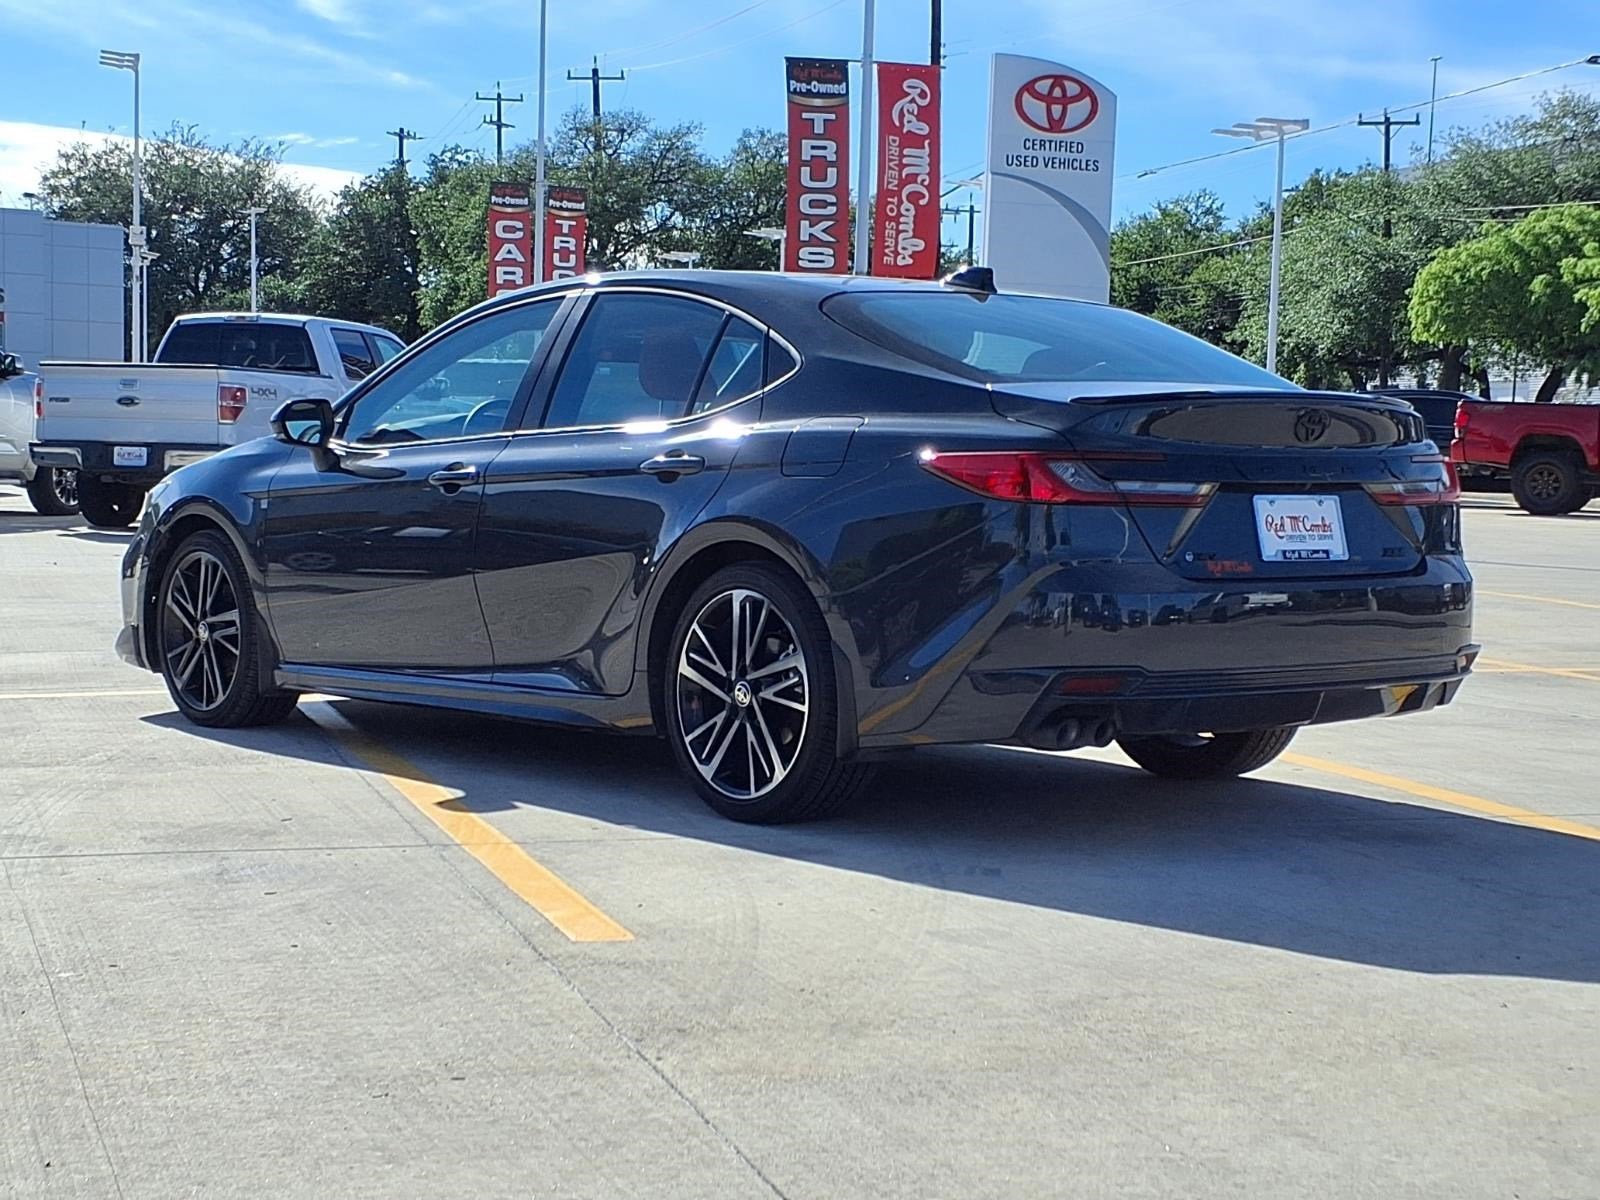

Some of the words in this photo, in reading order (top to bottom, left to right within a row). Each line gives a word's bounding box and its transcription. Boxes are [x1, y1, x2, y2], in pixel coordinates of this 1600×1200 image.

[789, 79, 847, 95] Pre-Owned
[892, 78, 931, 136] Red
[1023, 138, 1085, 154] CERTIFIED
[887, 135, 900, 191] DRIVEN
[1006, 154, 1039, 168] USED
[1043, 157, 1100, 172] VEHICLES
[491, 195, 528, 205] Pre-Owned
[798, 112, 838, 269] TRUCKS
[896, 139, 930, 266] McCombs
[549, 200, 585, 210] Pre-Owned
[885, 196, 898, 217] TO
[883, 221, 897, 266] SERVE
[494, 220, 525, 297] CAR
[1265, 514, 1285, 540] Red
[1286, 515, 1334, 533] McCombs
